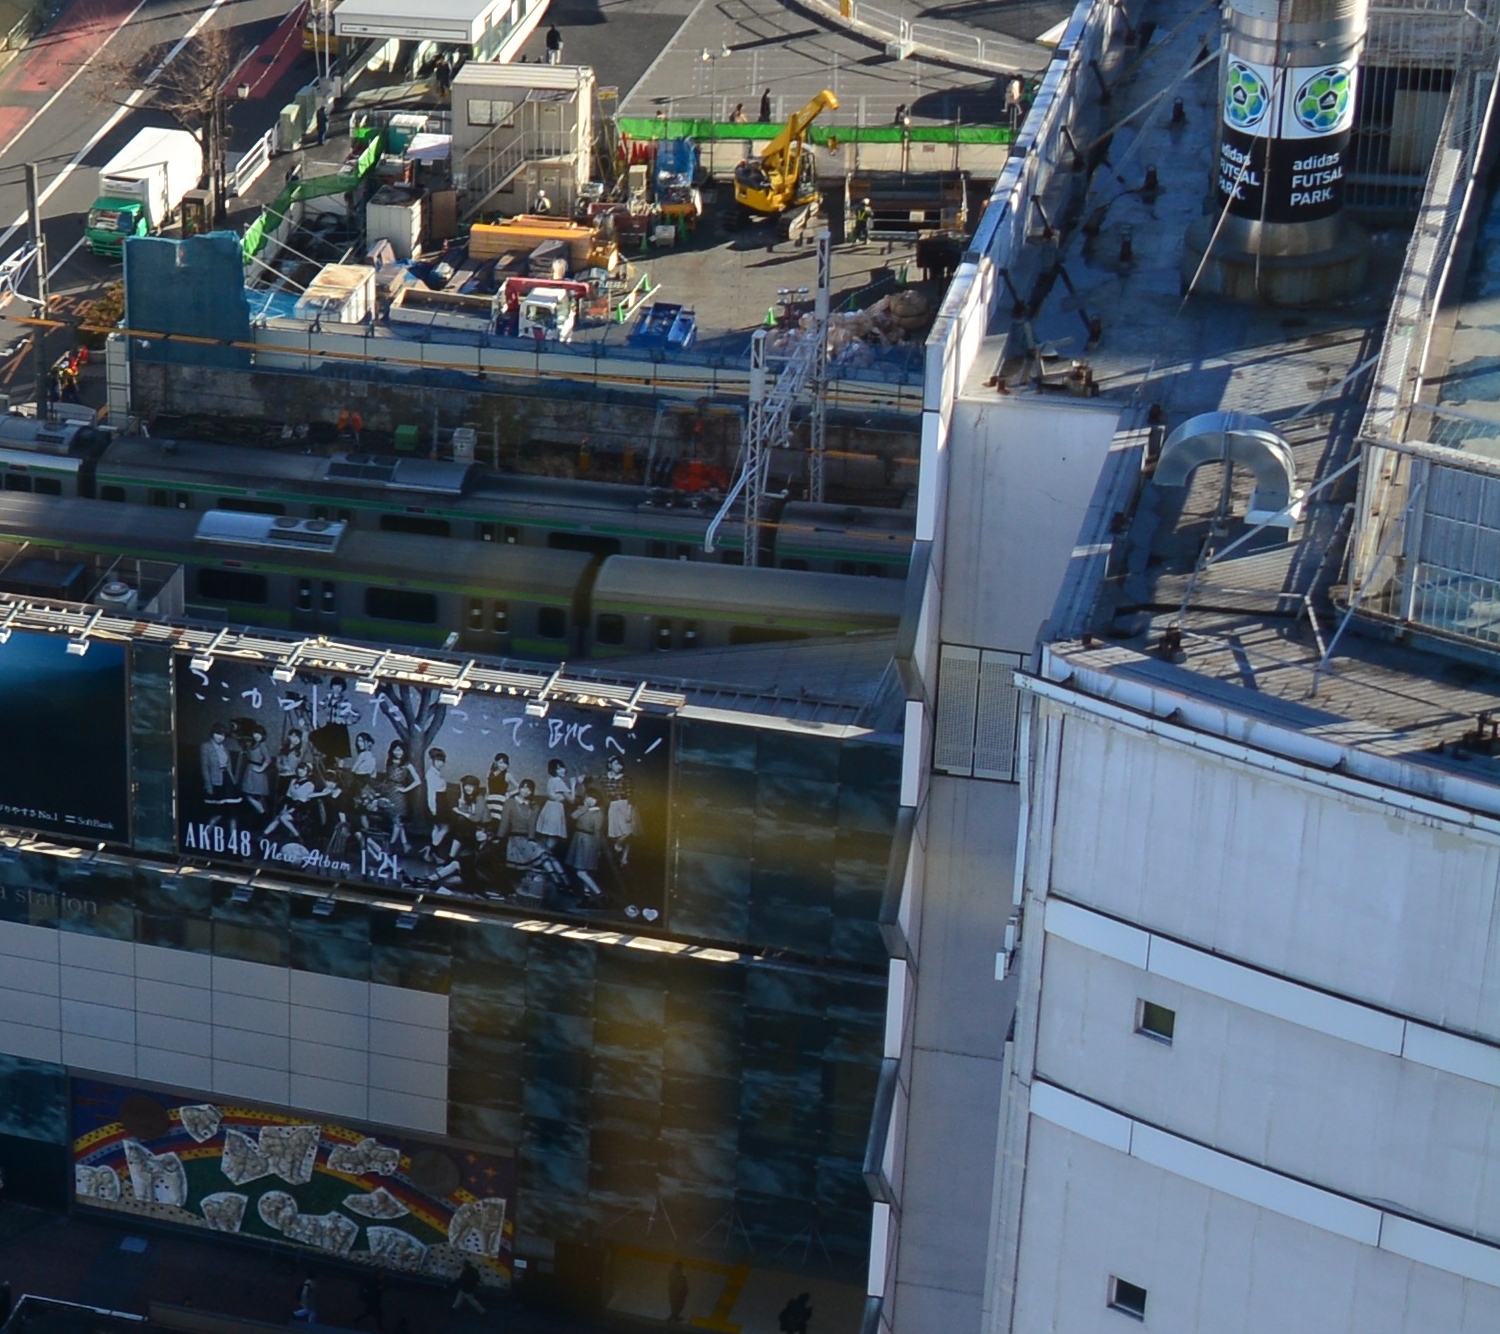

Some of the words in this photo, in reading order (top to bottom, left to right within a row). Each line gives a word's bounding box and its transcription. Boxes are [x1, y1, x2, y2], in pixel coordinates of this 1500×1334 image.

[1292, 152, 1340, 172] adidas
[1291, 168, 1344, 189] FUTSAL
[77, 817, 115, 831] SoftBank
[185, 821, 251, 857] AKB48
[259, 838, 299, 862] New
[15, 881, 98, 916] station
